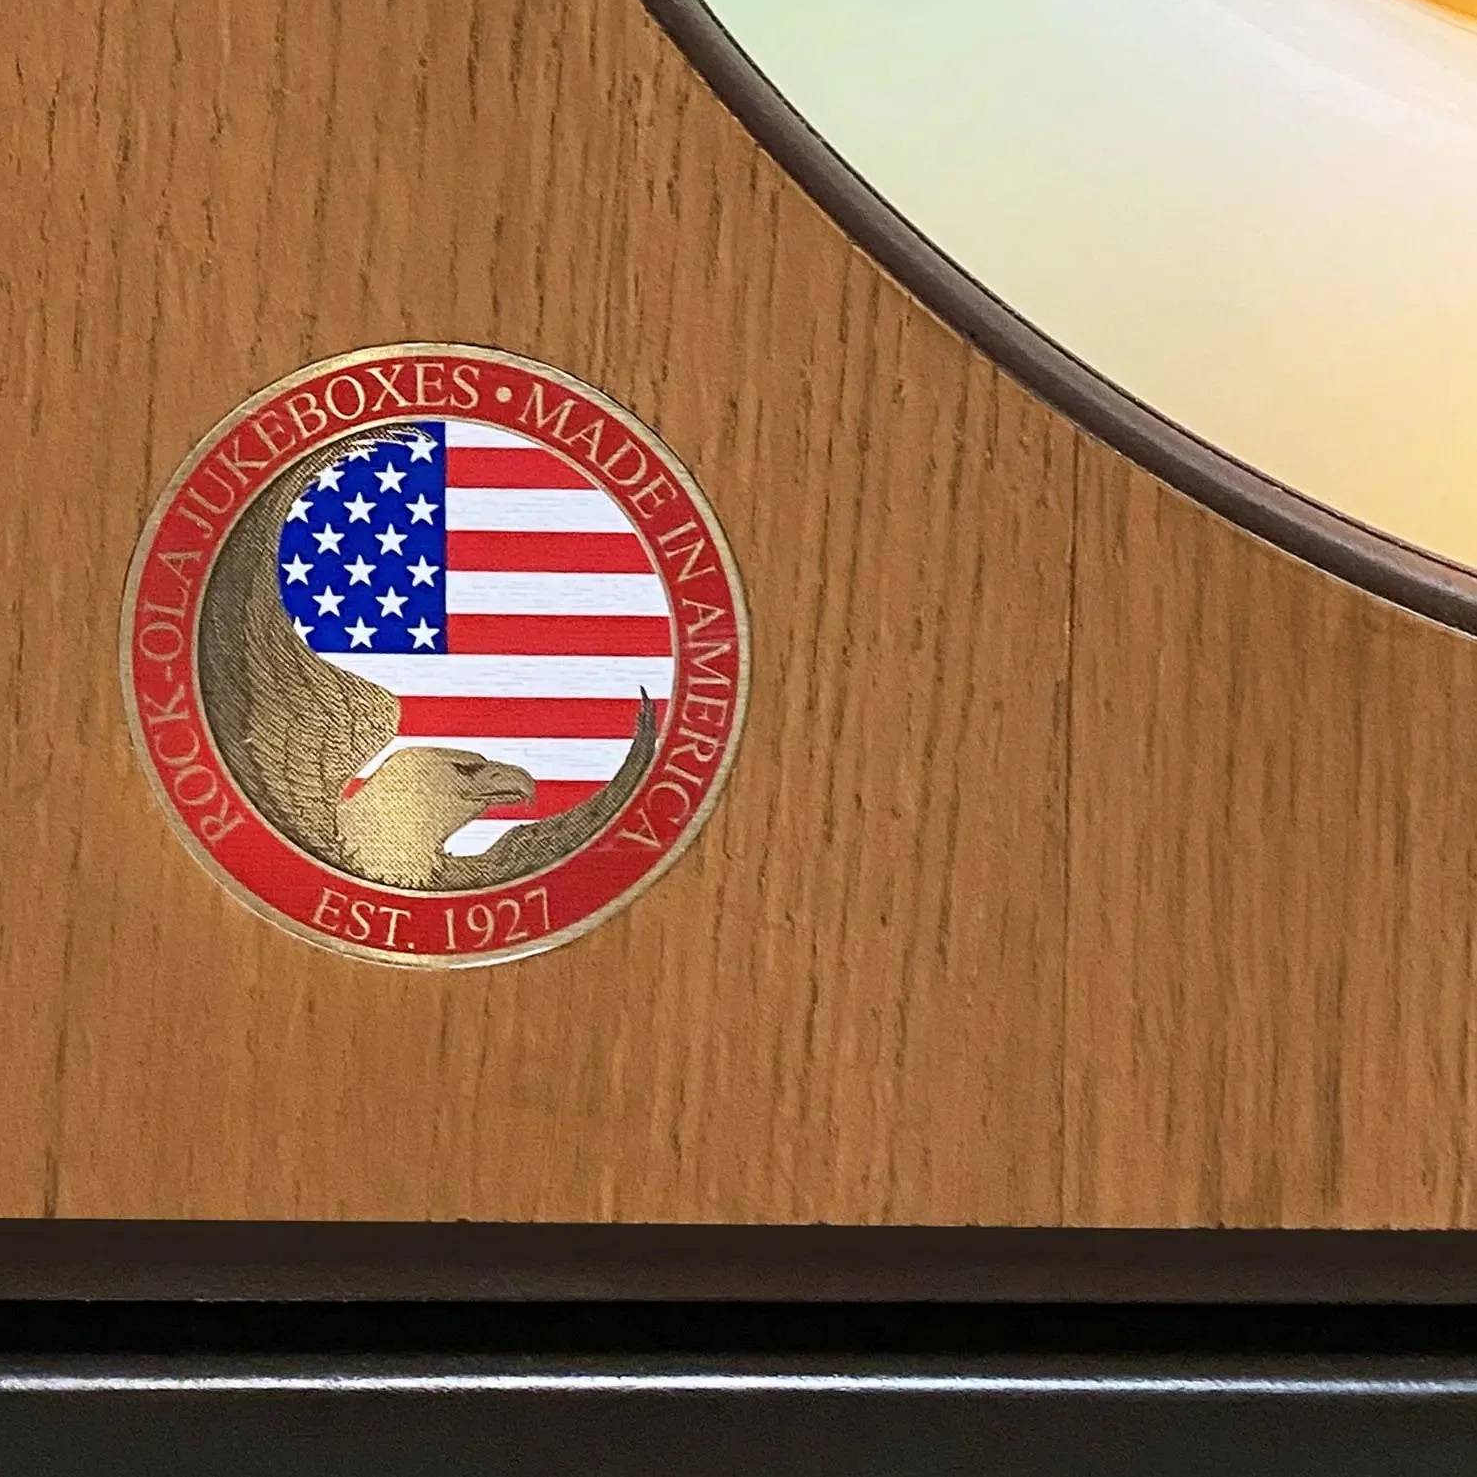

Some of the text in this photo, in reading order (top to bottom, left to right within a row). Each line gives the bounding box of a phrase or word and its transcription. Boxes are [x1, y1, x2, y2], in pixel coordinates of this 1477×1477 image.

[139, 363, 735, 850] ROCK-OLA JUKEBOXES MADE IN AMERICA
[313, 887, 552, 951] EST. 1927
